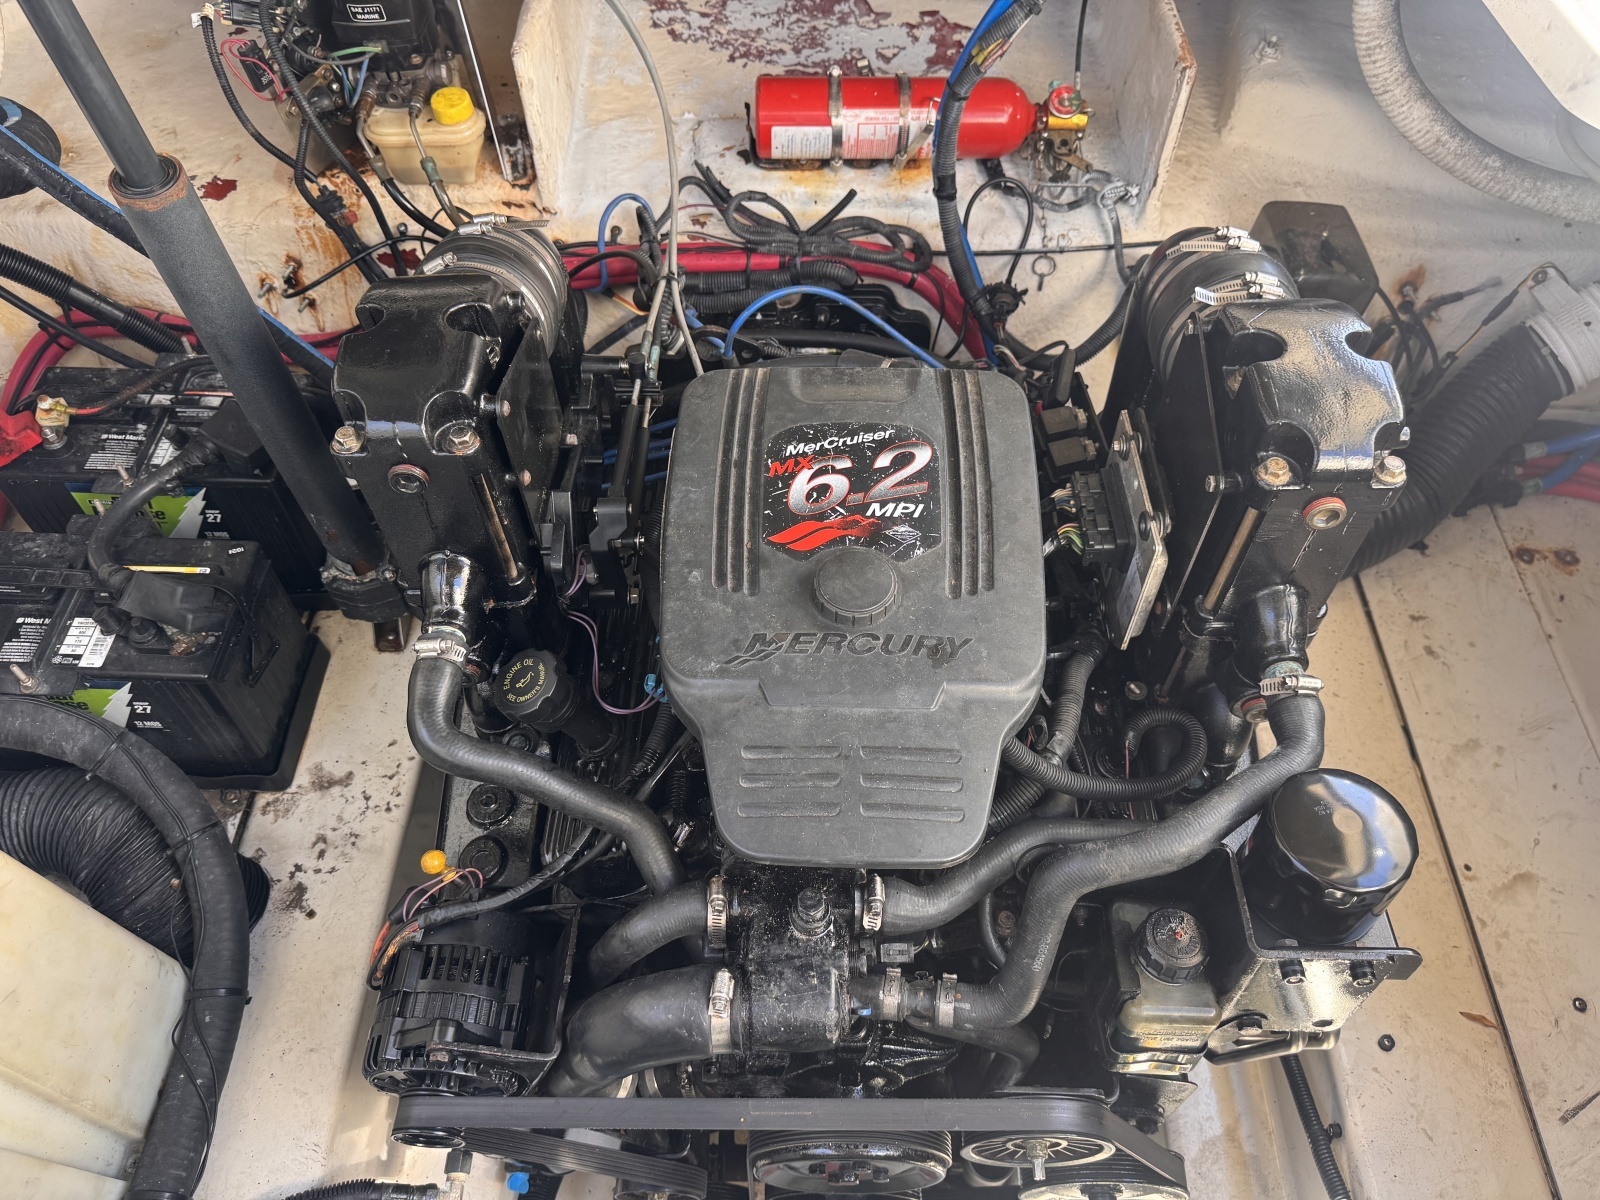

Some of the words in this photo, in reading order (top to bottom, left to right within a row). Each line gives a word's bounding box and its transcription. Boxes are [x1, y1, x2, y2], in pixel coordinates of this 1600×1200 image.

[785, 430, 895, 457] MerCruiser
[768, 455, 815, 478] MX
[788, 439, 933, 515] 6.2
[206, 514, 222, 523] 27
[866, 502, 925, 518] MPI
[743, 632, 974, 660] MERCURY
[503, 661, 522, 690] ENGINE
[523, 658, 534, 666] OIL
[506, 693, 517, 702] SEE
[134, 705, 152, 714] 27
